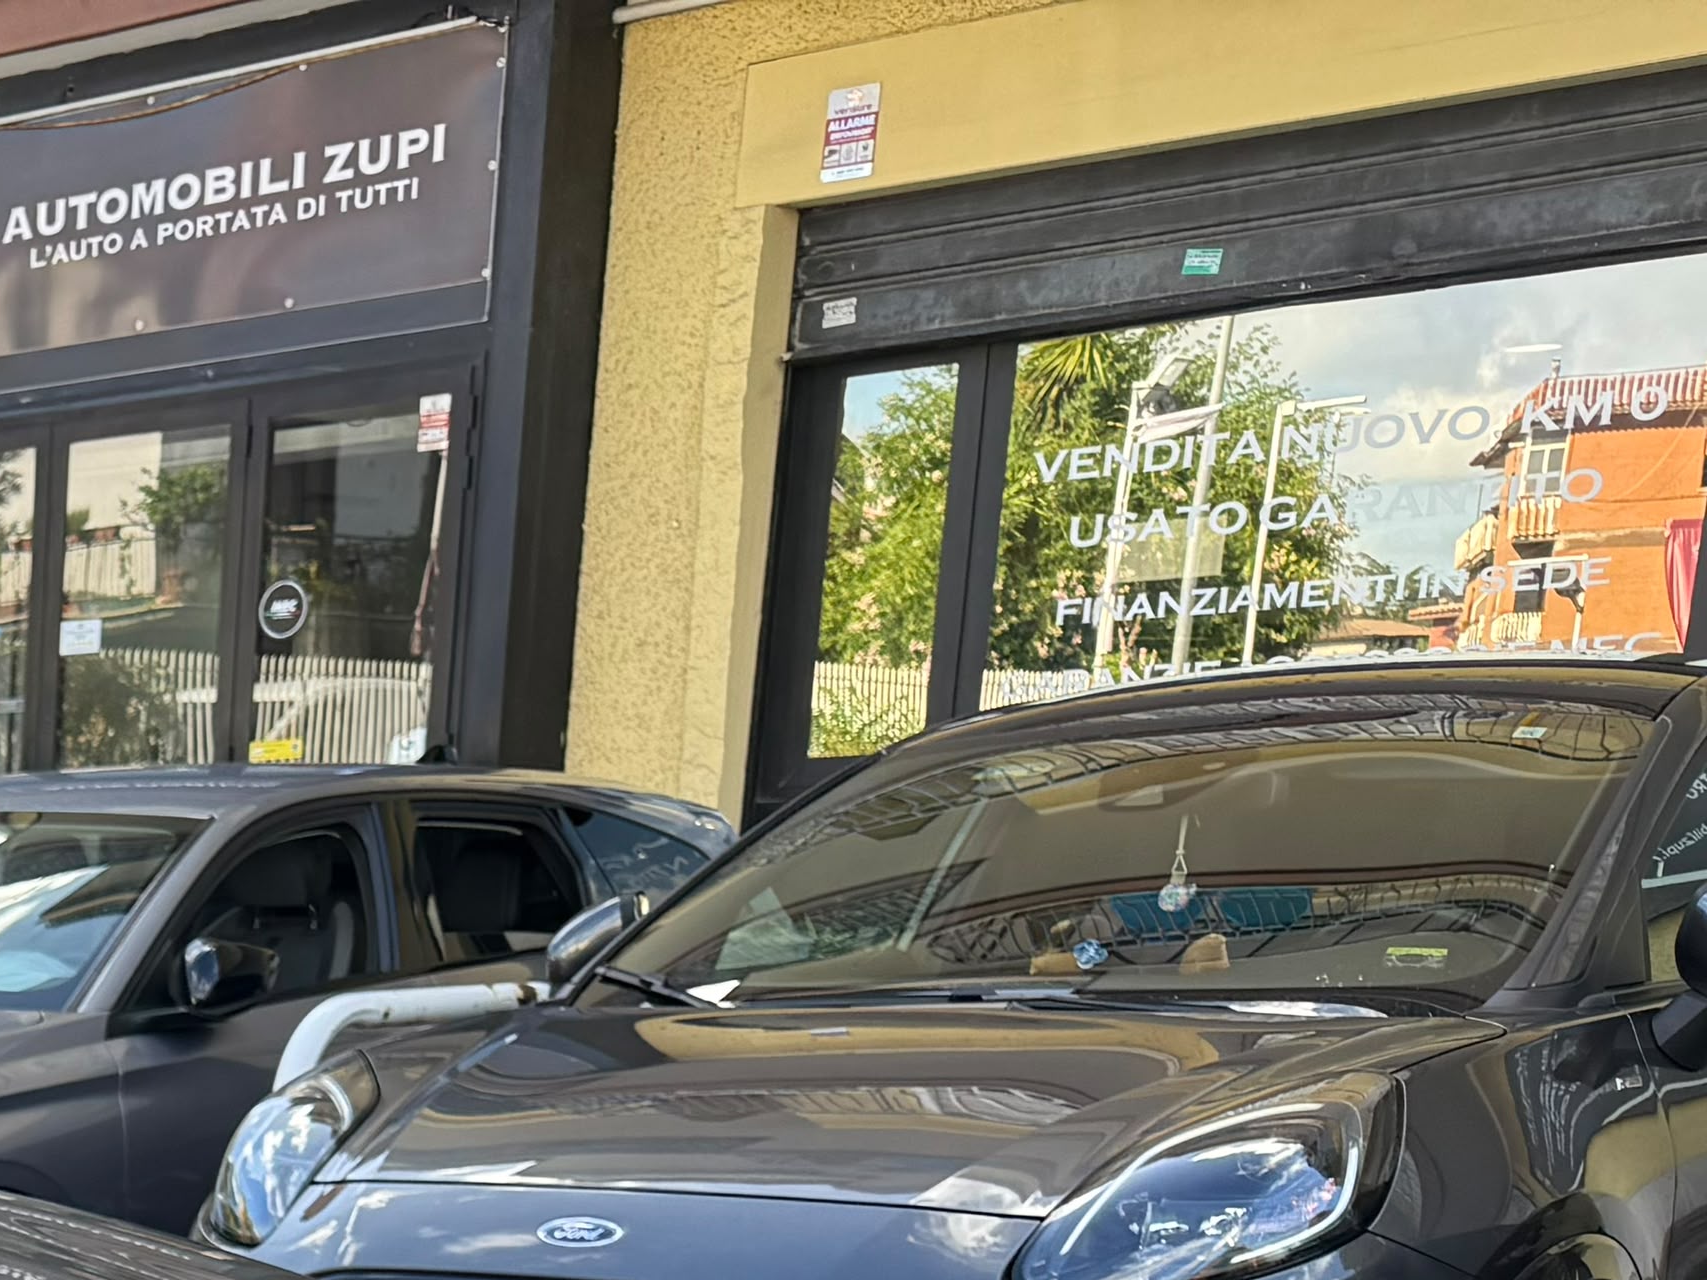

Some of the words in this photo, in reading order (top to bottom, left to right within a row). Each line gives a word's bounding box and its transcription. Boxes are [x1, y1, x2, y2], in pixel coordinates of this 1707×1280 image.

[1, 150, 307, 245] AUTOMOBILI
[322, 122, 447, 184] ZUPI
[29, 231, 124, 269] L'AUTO
[129, 227, 149, 251] A
[156, 202, 289, 246] PORTATA
[296, 194, 327, 221] DI
[334, 176, 420, 214] TUTTI
[1033, 429, 1267, 485] VENDITA
[1520, 391, 1613, 435] KM
[1069, 500, 1249, 549] USATO
[1055, 571, 1407, 627] FINANZIAMENTI
[1413, 568, 1471, 600] IN
[1479, 556, 1613, 595] SEDE
[554, 1222, 605, 1240] Ford
